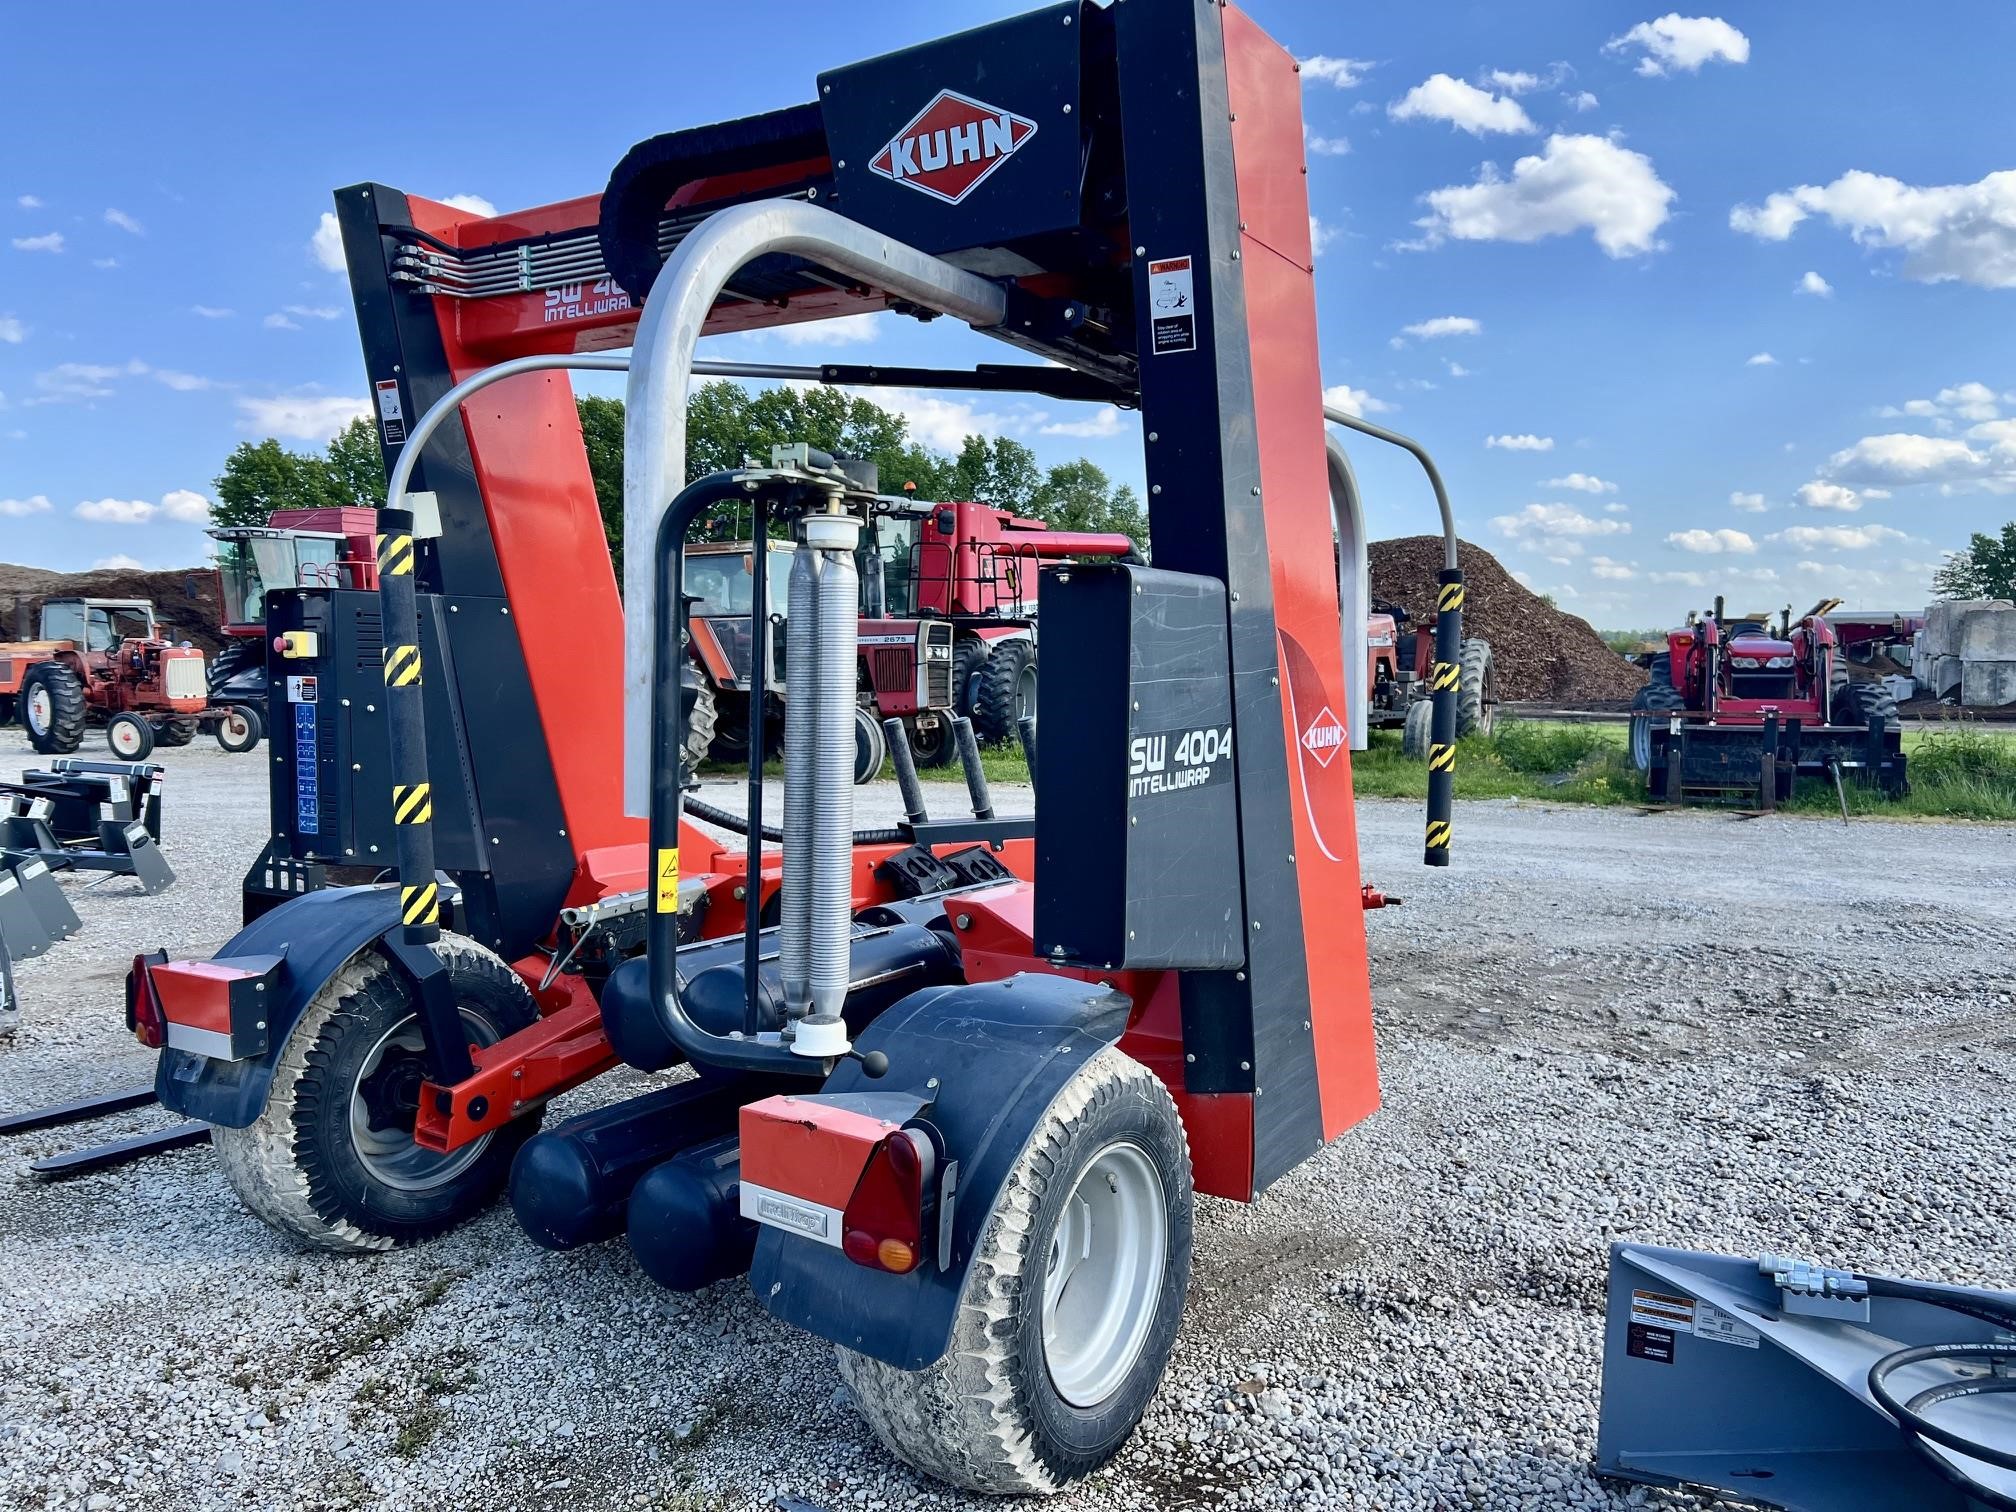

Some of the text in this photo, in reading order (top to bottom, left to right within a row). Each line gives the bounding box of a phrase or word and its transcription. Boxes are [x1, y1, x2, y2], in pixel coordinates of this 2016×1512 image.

[889, 113, 1014, 179] KUHN
[1129, 727, 1232, 775] SW 4004
[1308, 725, 1341, 749] KUHN
[1129, 766, 1211, 798] INTELLIWRAP
